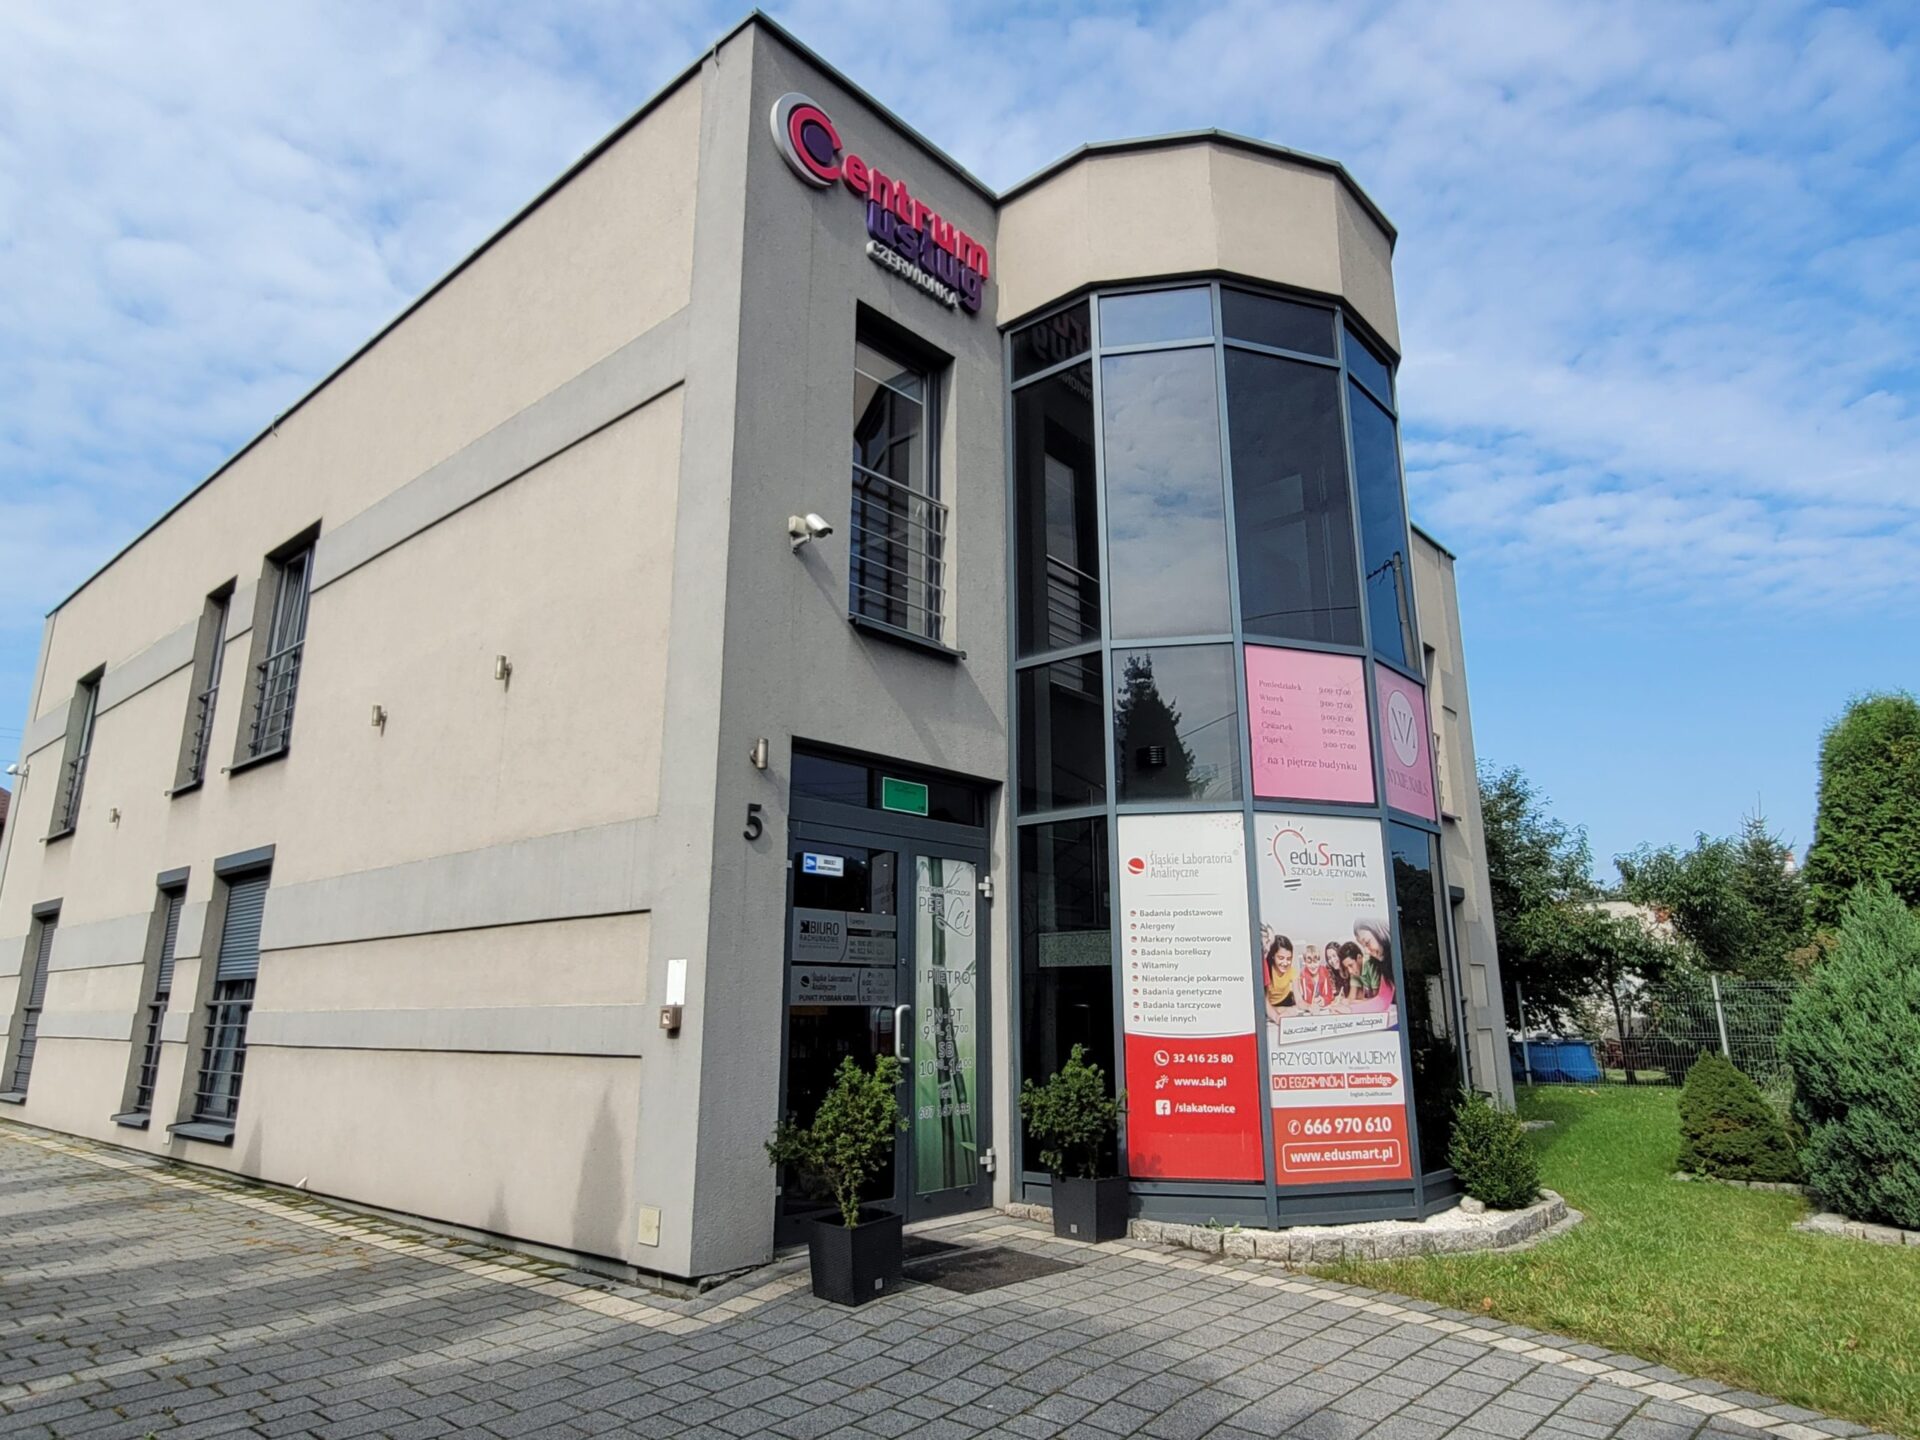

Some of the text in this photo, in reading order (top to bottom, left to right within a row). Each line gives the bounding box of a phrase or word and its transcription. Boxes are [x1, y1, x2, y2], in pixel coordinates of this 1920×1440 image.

[770, 92, 989, 281] Centrum
[1267, 757, 1279, 765] na
[1287, 757, 1318, 769] piętrze
[1318, 758, 1358, 772] budynku
[743, 803, 763, 840] 5
[1150, 851, 1232, 868] Śląskie Laboratoria
[1290, 843, 1366, 868] eduSmart
[1150, 867, 1199, 881] Analityczne
[1291, 867, 1367, 879] SZKOŁA JĘZYKOWA
[1173, 909, 1223, 918] podstawowe
[810, 921, 840, 936] BIURO
[1140, 922, 1175, 931] Alergeny
[1140, 935, 1172, 944] Markery
[1141, 948, 1212, 957] Badania boreliozy
[1141, 961, 1179, 970] Witaminy
[1141, 974, 1245, 983] Nietolerancje pokarmowe
[1176, 988, 1222, 997] genetyczne
[1142, 1001, 1222, 1010] Badania tarczycowe
[926, 1008, 963, 1022] PN-PT
[1147, 1014, 1169, 1022] wiele
[1170, 1014, 1197, 1024] innych
[938, 1041, 954, 1058] SB
[1173, 1053, 1234, 1063] 32 416 25 80
[1271, 1050, 1397, 1066] PRZYGOTOWYWUJEMY
[1174, 1076, 1227, 1088] www.sla.pl
[1273, 1077, 1287, 1089] DO
[1348, 1074, 1392, 1087] Cambridge
[1175, 1102, 1236, 1114] /slakatowice
[1304, 1116, 1392, 1135] 666 970 610
[1290, 1146, 1393, 1163] www.edusmart.pl
